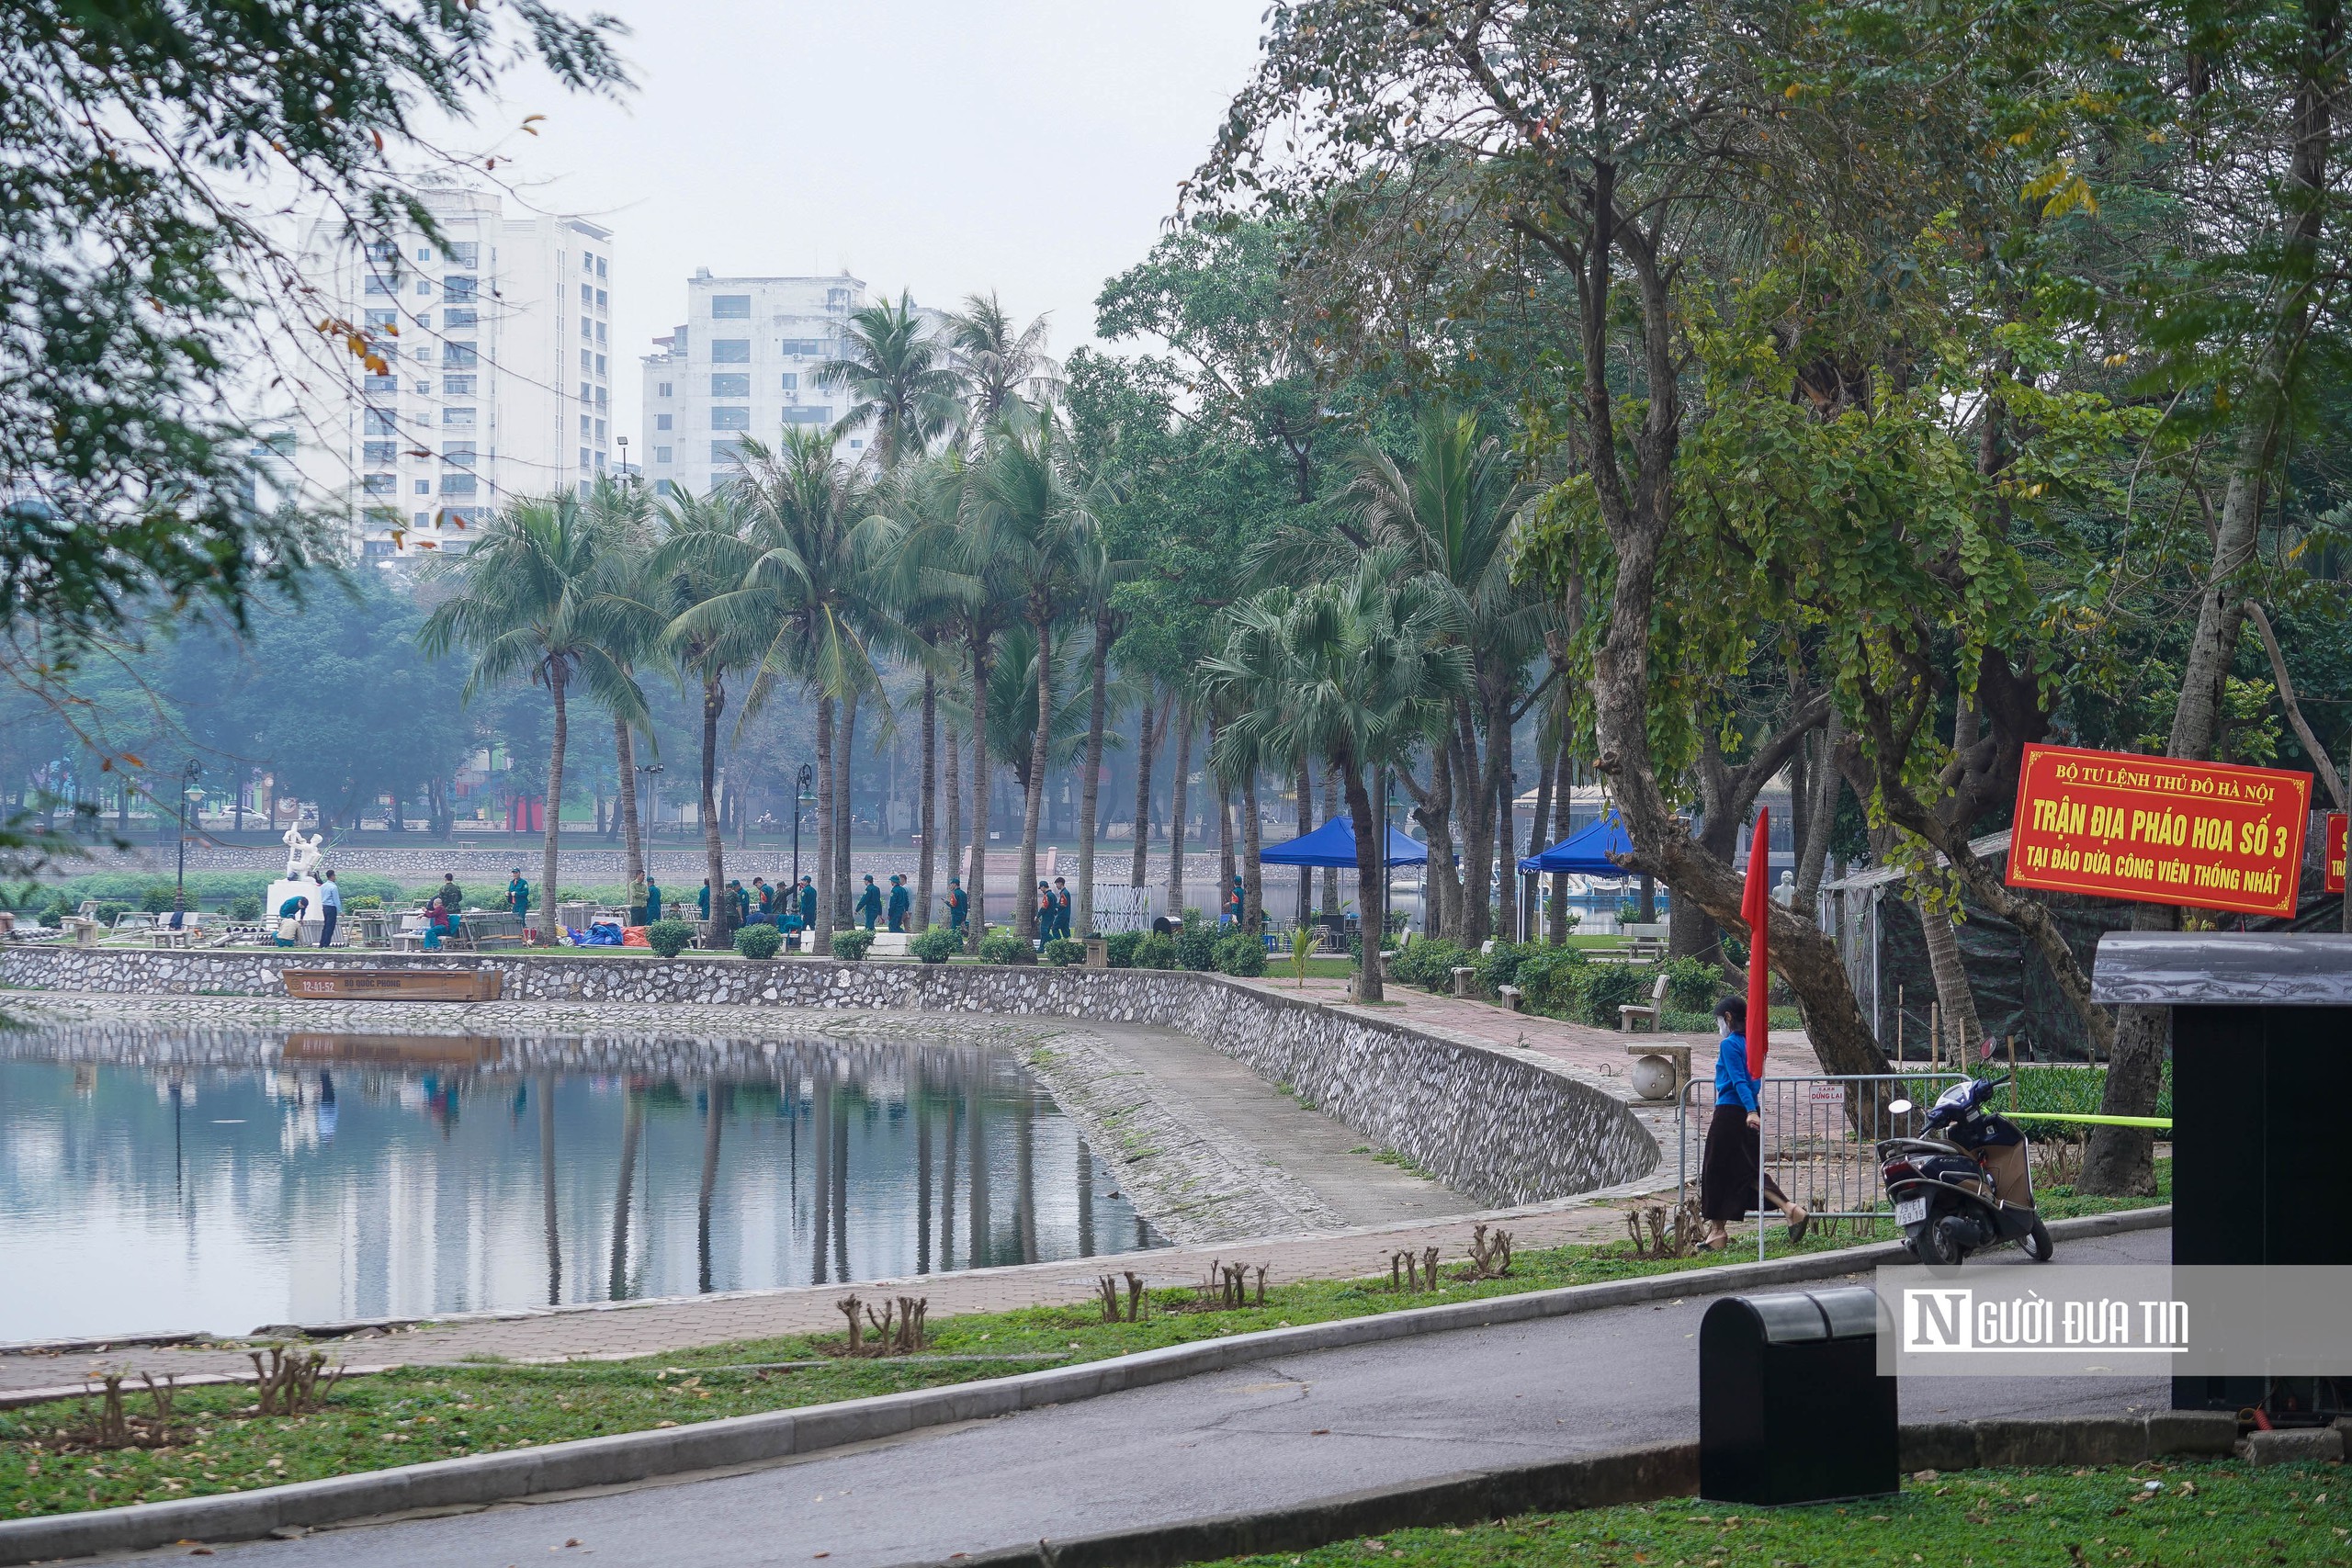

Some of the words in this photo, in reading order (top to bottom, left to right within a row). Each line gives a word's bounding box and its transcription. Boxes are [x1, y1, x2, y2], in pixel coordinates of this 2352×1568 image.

[2055, 761, 2078, 783] BỘ
[2082, 767, 2105, 782] TƯ
[2106, 767, 2151, 788] LỆNH
[2154, 773, 2188, 791] THỦ
[2189, 776, 2214, 794] ĐÔ
[2217, 779, 2240, 797] HÀ
[2245, 783, 2276, 804] NỘI
[2032, 795, 2086, 840] TRẬN
[2090, 805, 2124, 845] ĐỊA
[2130, 807, 2188, 847] PHÁO
[2191, 816, 2233, 852] HOA
[2239, 813, 2272, 856] SỐ
[2273, 826, 2288, 858] 3
[2026, 845, 2049, 872] TẠI
[2051, 842, 2080, 871] ĐẢO
[2082, 849, 2111, 875] DỪA
[2115, 852, 2154, 880] CÔNG
[2157, 858, 2190, 885] VIÊN
[2193, 860, 2241, 890] THỐNG
[2243, 866, 2282, 896] NHẤT
[302, 980, 335, 993] 12-41-52
[1897, 1209, 1925, 1226] 759.19
